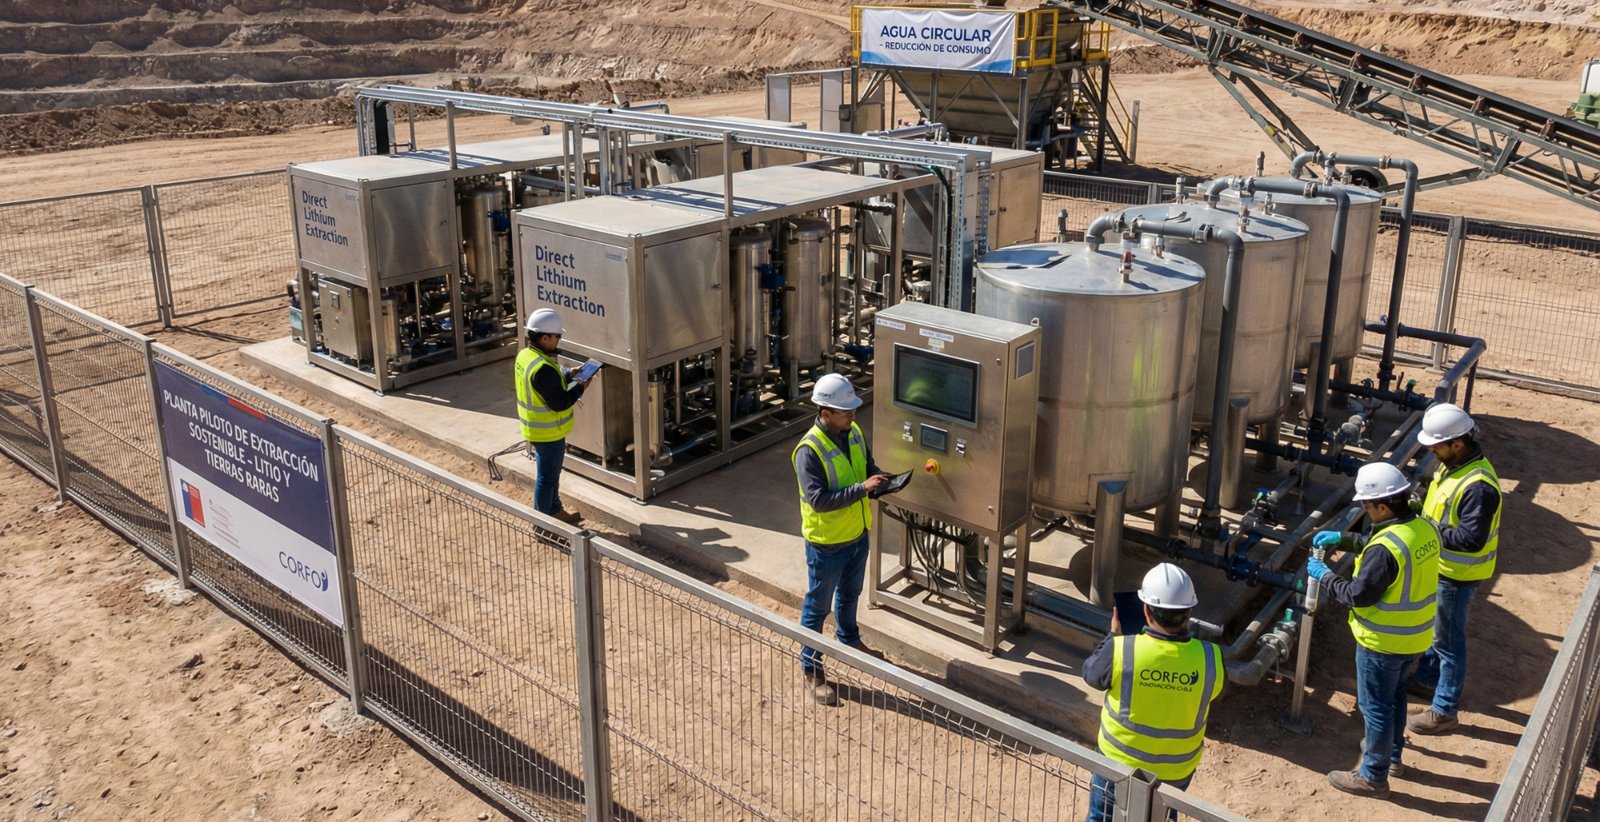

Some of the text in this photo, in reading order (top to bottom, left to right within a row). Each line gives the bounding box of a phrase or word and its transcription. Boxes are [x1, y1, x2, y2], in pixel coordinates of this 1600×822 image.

[880, 25, 991, 42] AGUA CIRCULAR
[885, 41, 931, 51] REDUCCIÓN
[933, 44, 944, 52] DE
[946, 45, 991, 55] CONSUMO
[302, 190, 328, 209] Direct
[304, 207, 336, 227] Lithium
[305, 223, 348, 246] Extraction
[535, 245, 575, 269] Direct
[536, 265, 586, 292] Lithium
[537, 285, 605, 317] Extraction
[163, 390, 319, 482] PLANTA PILOTO DE EXTRACCIÓN
[188, 422, 246, 465] SOSTENIBLE
[254, 455, 281, 483] LITIO
[283, 470, 291, 488] Y
[204, 449, 279, 503] TIERRAS RARAS
[1415, 539, 1437, 560] CORFO
[279, 551, 321, 589] CORFO
[1140, 669, 1190, 685] CORFO
